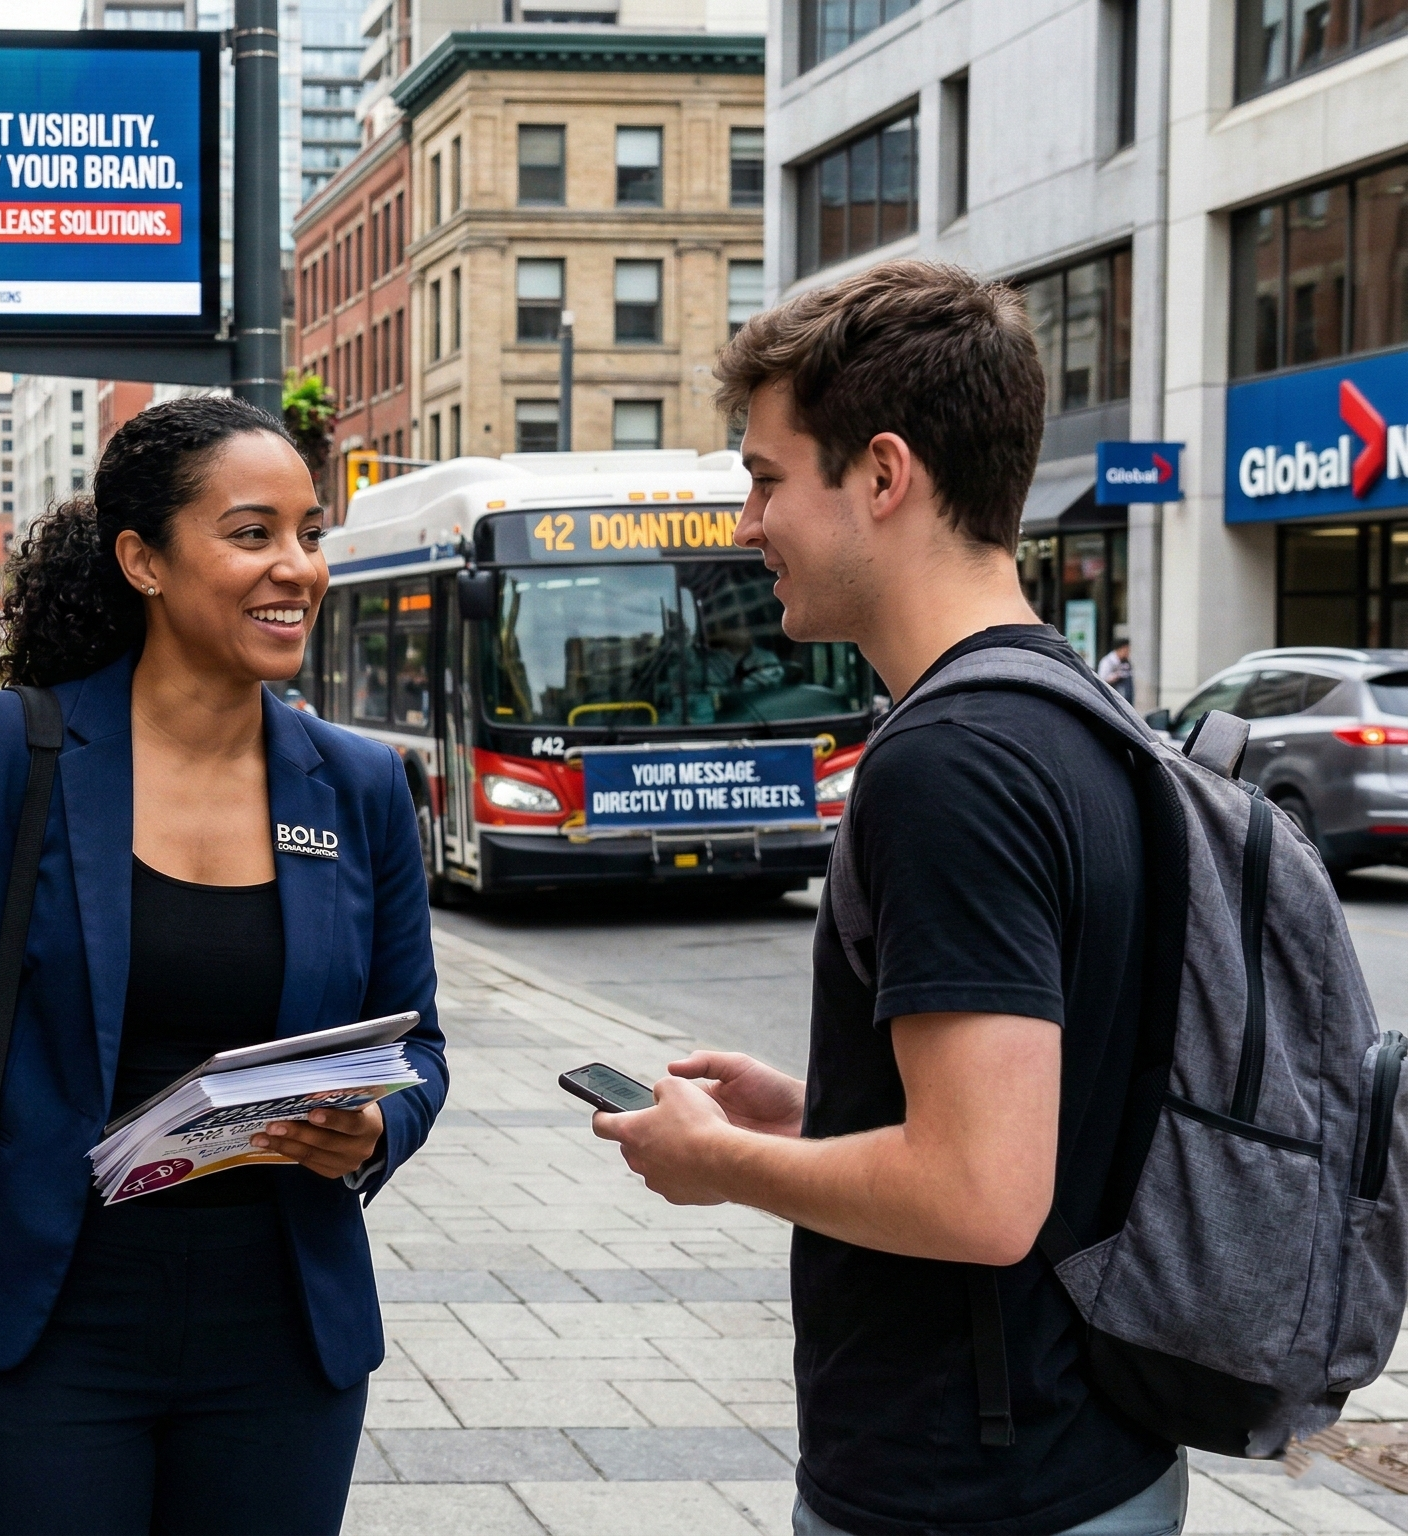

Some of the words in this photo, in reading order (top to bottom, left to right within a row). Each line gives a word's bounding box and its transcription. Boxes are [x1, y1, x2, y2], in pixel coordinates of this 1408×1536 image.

[19, 113, 159, 148] VISIBILITY.
[7, 154, 78, 189] YOUR
[84, 155, 183, 190] BRAND.
[60, 210, 172, 237] SOLUTIONS.
[1105, 466, 1159, 485] Global
[1239, 434, 1352, 498] Global
[534, 513, 576, 551] 42
[531, 736, 565, 756] #42
[632, 763, 676, 786] YOUR
[679, 760, 761, 784] MESSAGE.
[593, 790, 668, 814] DIRECTLY
[671, 790, 693, 812] TO
[695, 787, 728, 810] THE
[731, 785, 805, 809] STREETS.
[277, 823, 339, 849] BOLD
